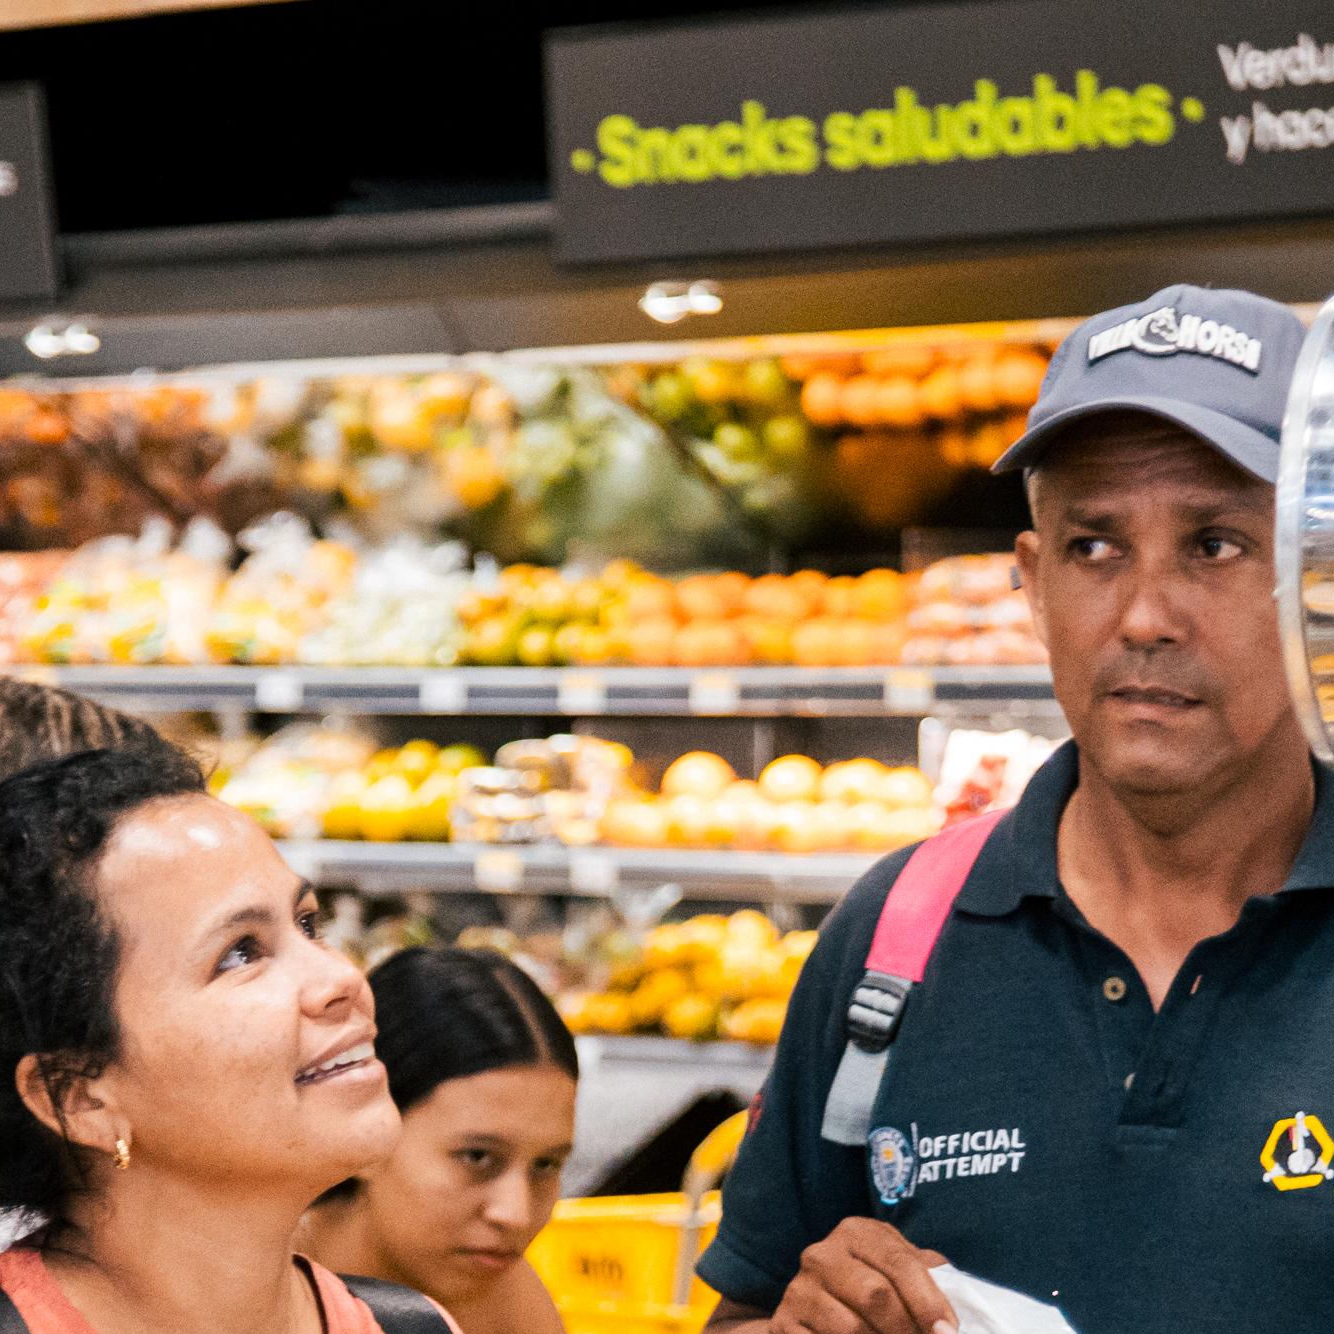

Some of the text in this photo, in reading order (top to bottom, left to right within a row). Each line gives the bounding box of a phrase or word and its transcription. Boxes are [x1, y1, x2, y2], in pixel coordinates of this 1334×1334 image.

[596, 69, 1174, 188] Snacks saludables
[1219, 115, 1249, 166] y
[919, 1128, 1026, 1159] OFFICIAL
[917, 1151, 1026, 1184] ATTEMPT
